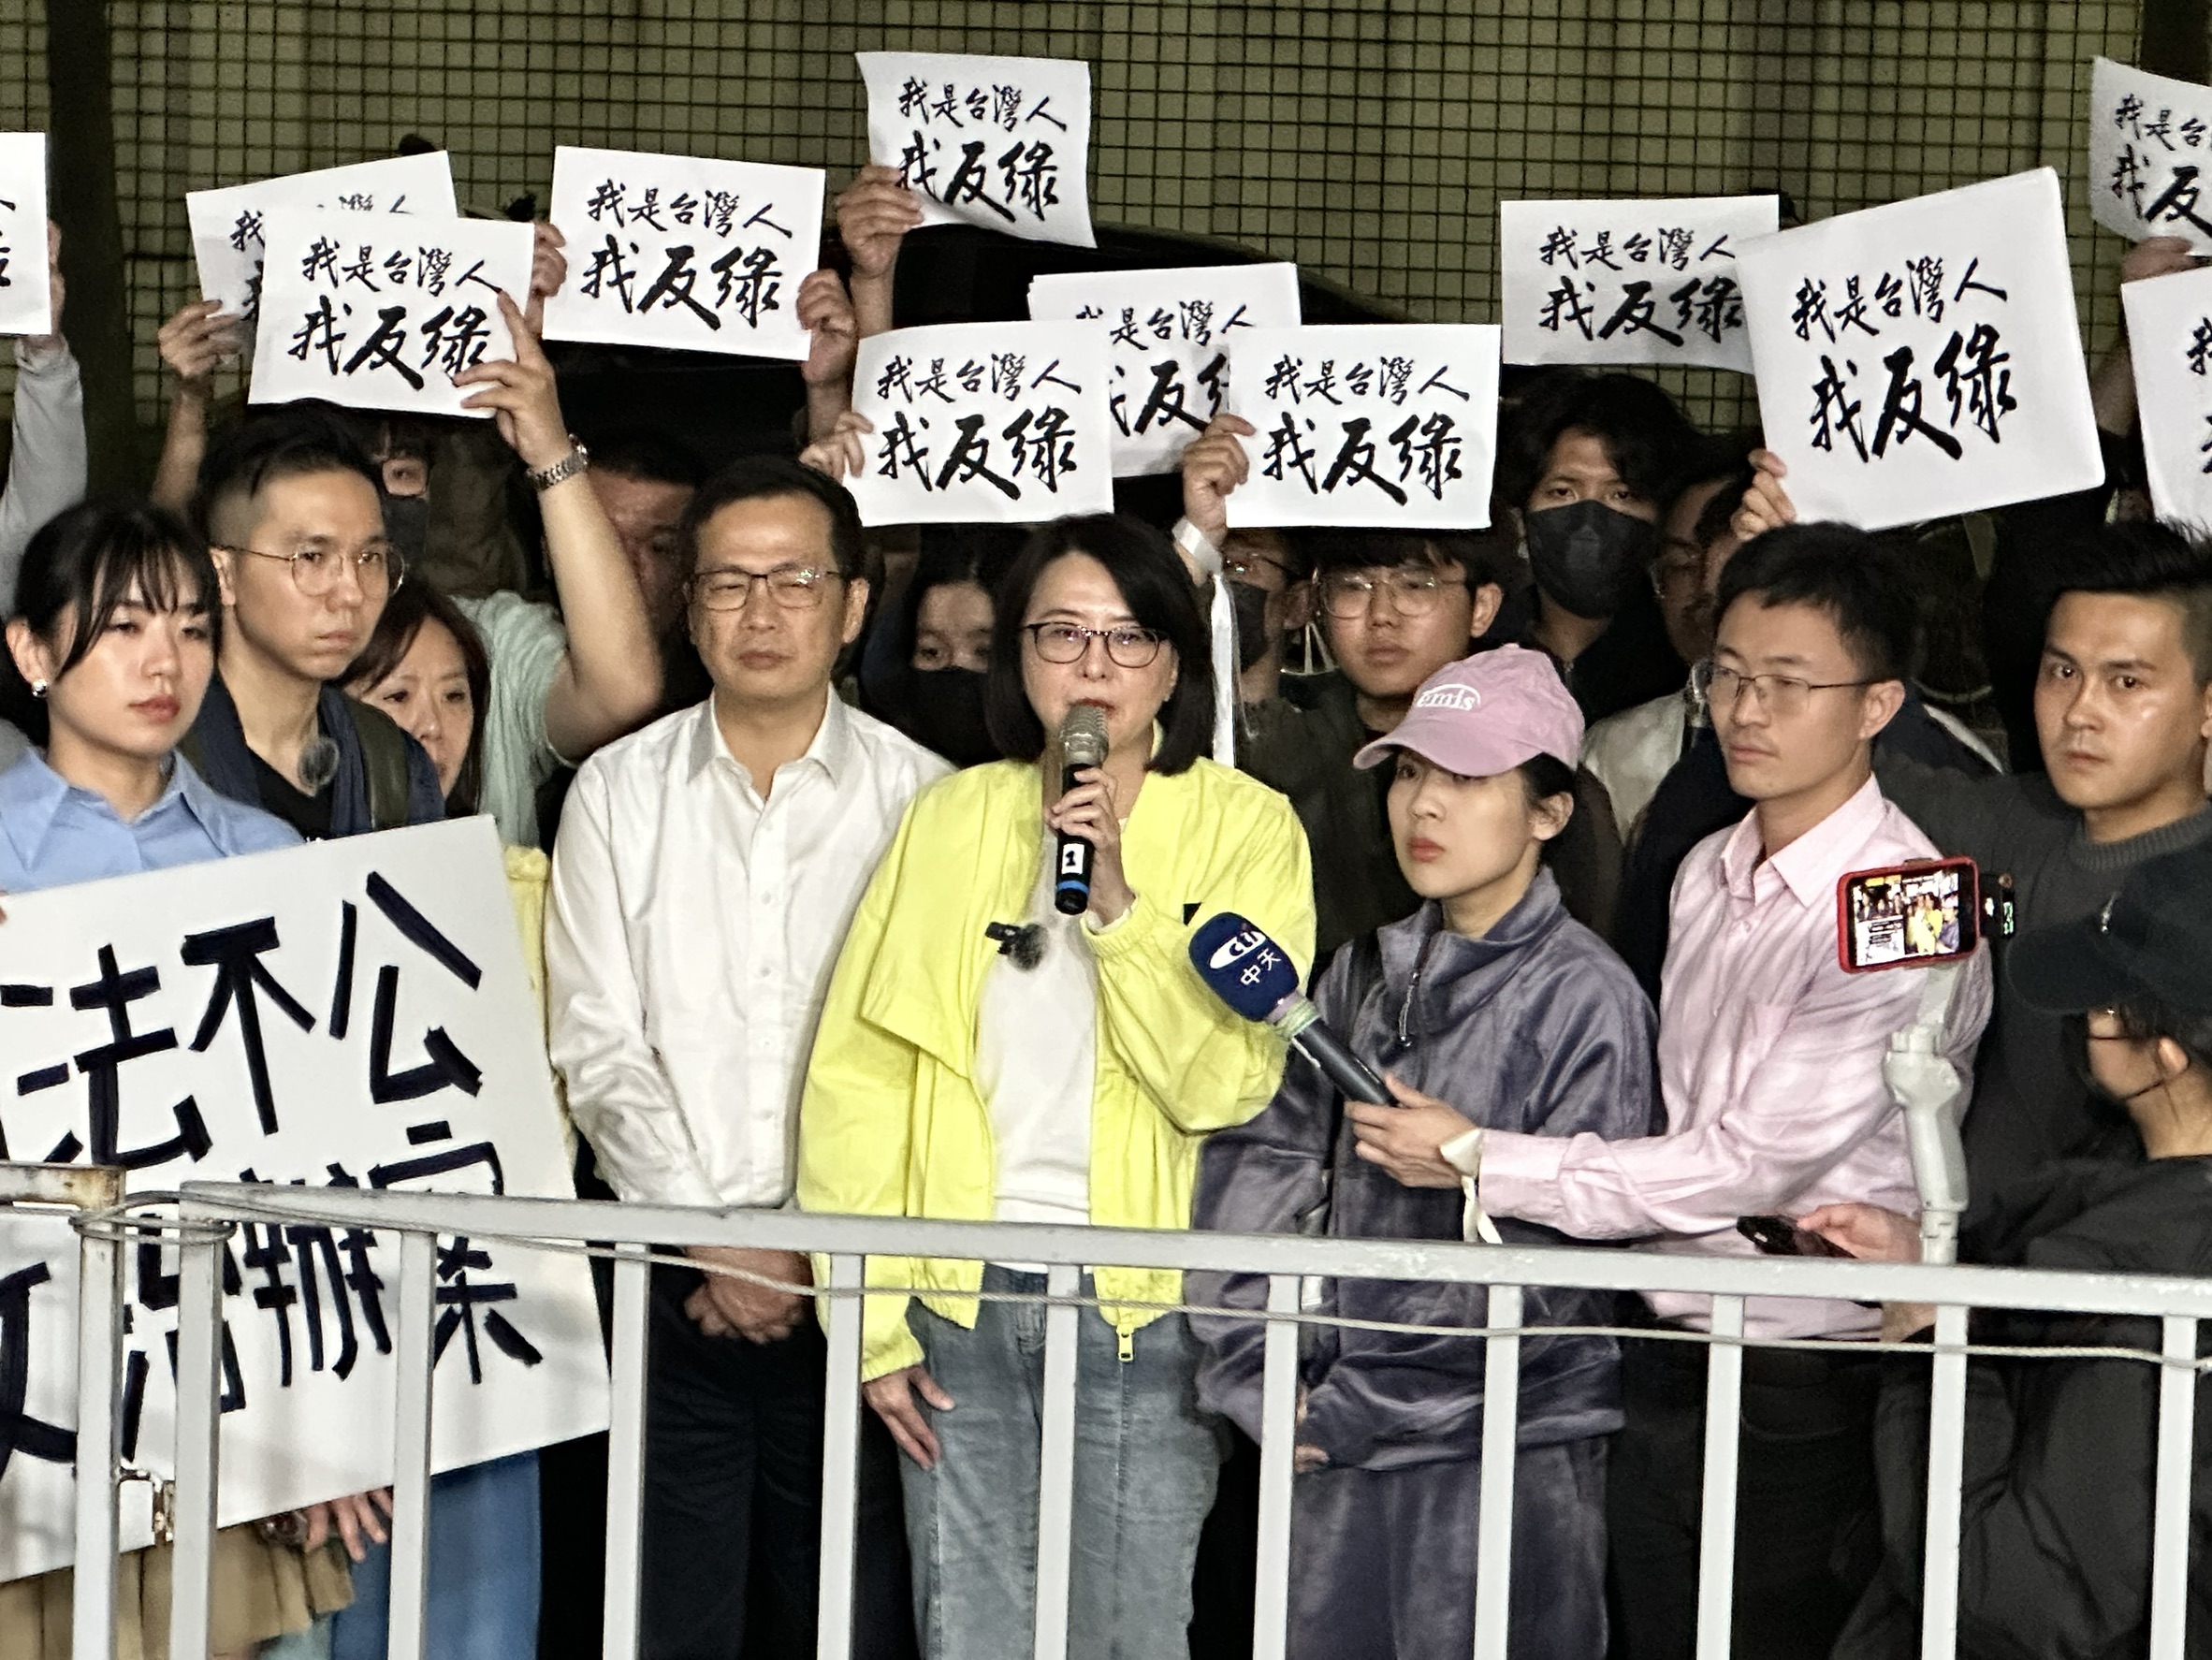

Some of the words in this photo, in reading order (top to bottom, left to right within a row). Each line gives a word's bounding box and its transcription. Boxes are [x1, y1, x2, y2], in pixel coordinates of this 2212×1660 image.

[898, 76, 1068, 132] 我是台灣人
[900, 129, 1059, 223] 我反綠
[587, 179, 793, 239] 我是台灣人
[302, 236, 502, 298] 我是台灣人
[1539, 226, 1737, 273] 我是台灣人
[580, 233, 783, 331] 我反綠
[1538, 275, 1742, 348] 我反綠
[1791, 255, 2008, 343] 我是台灣人
[288, 295, 492, 390] 我反綠
[877, 353, 1082, 404] 我是台灣人
[1264, 354, 1470, 406] 我是台灣人
[1809, 323, 2017, 463] 我反綠
[877, 405, 1078, 501] 我反綠
[1262, 411, 1463, 507] 我反綠
[1417, 689, 1475, 711] emis
[1065, 850, 1077, 867] 1
[1240, 947, 1282, 985] 中天
